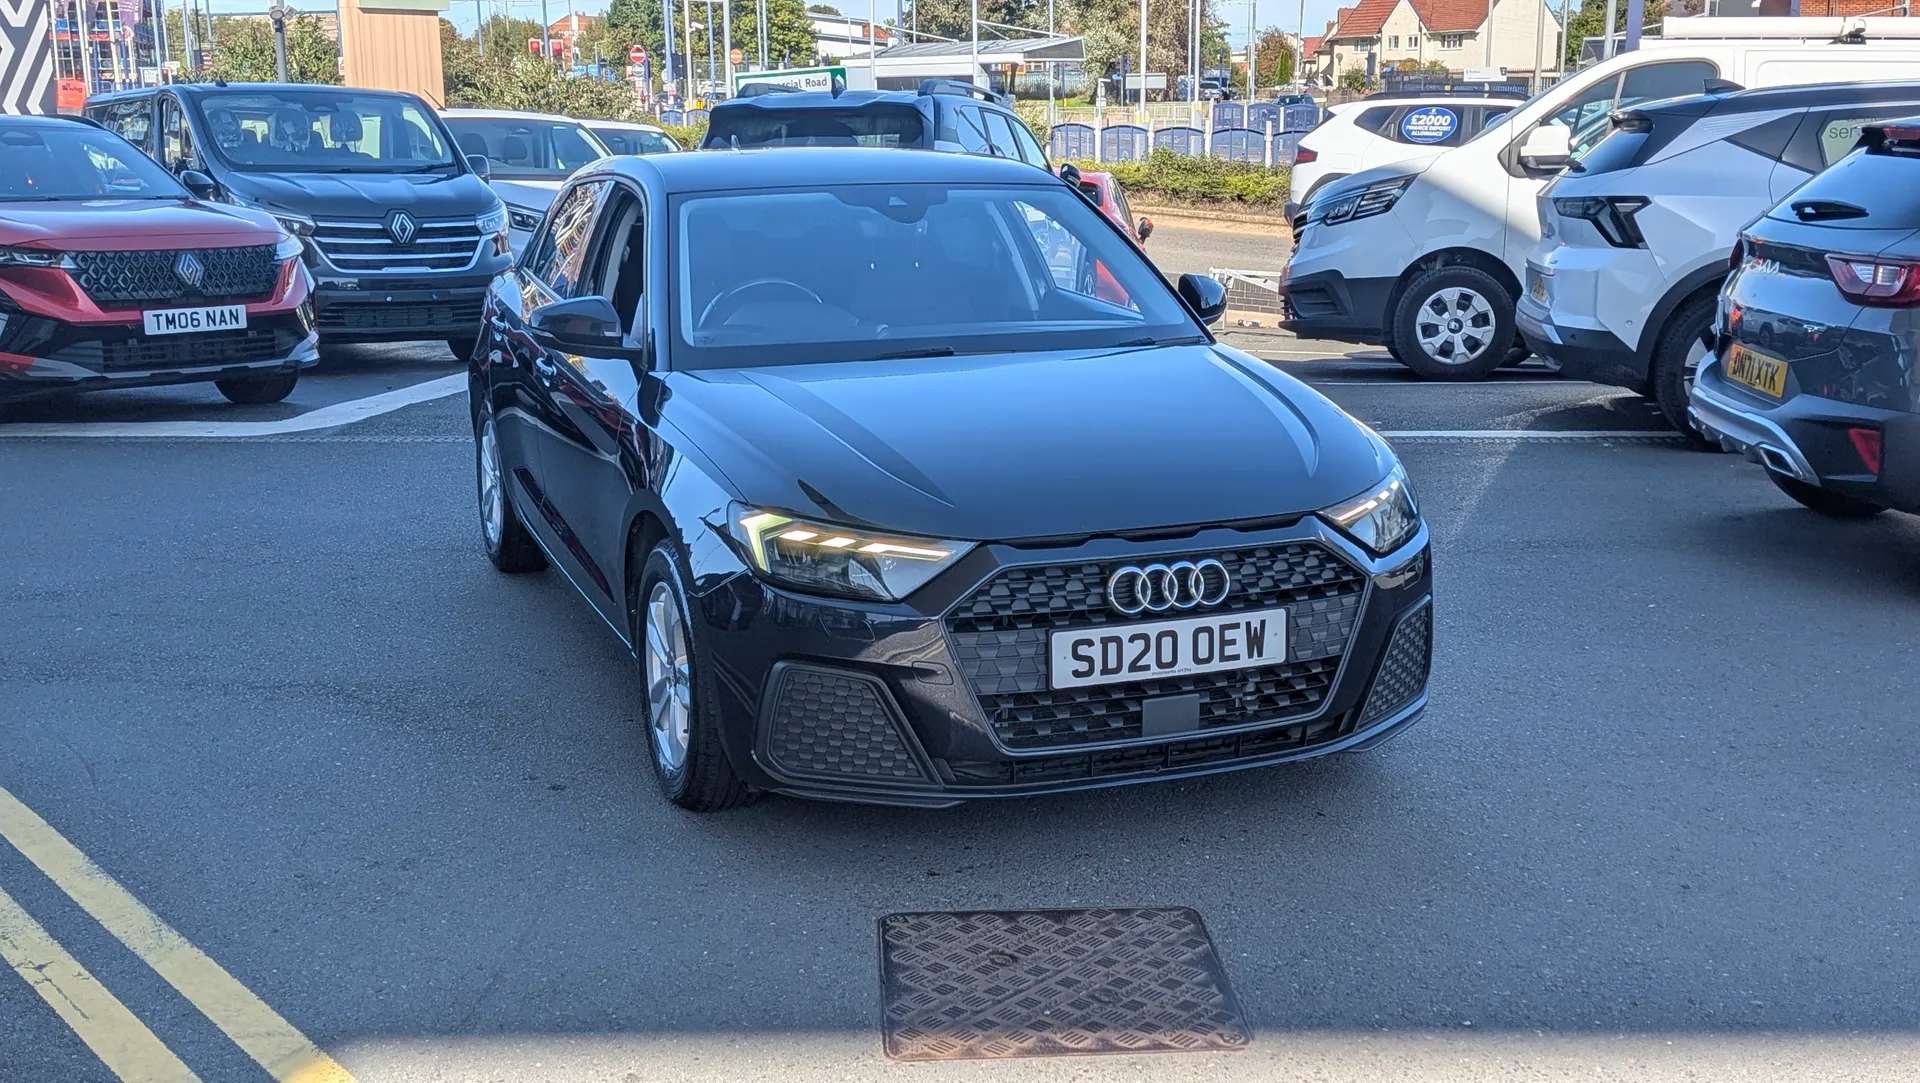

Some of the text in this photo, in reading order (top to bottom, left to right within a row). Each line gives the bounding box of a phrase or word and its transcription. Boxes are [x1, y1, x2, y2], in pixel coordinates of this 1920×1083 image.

[805, 76, 828, 87] Road
[1410, 114, 1451, 126] £2000
[152, 308, 240, 331] TM06 NAN
[1071, 619, 1267, 679] SD20 OEW
